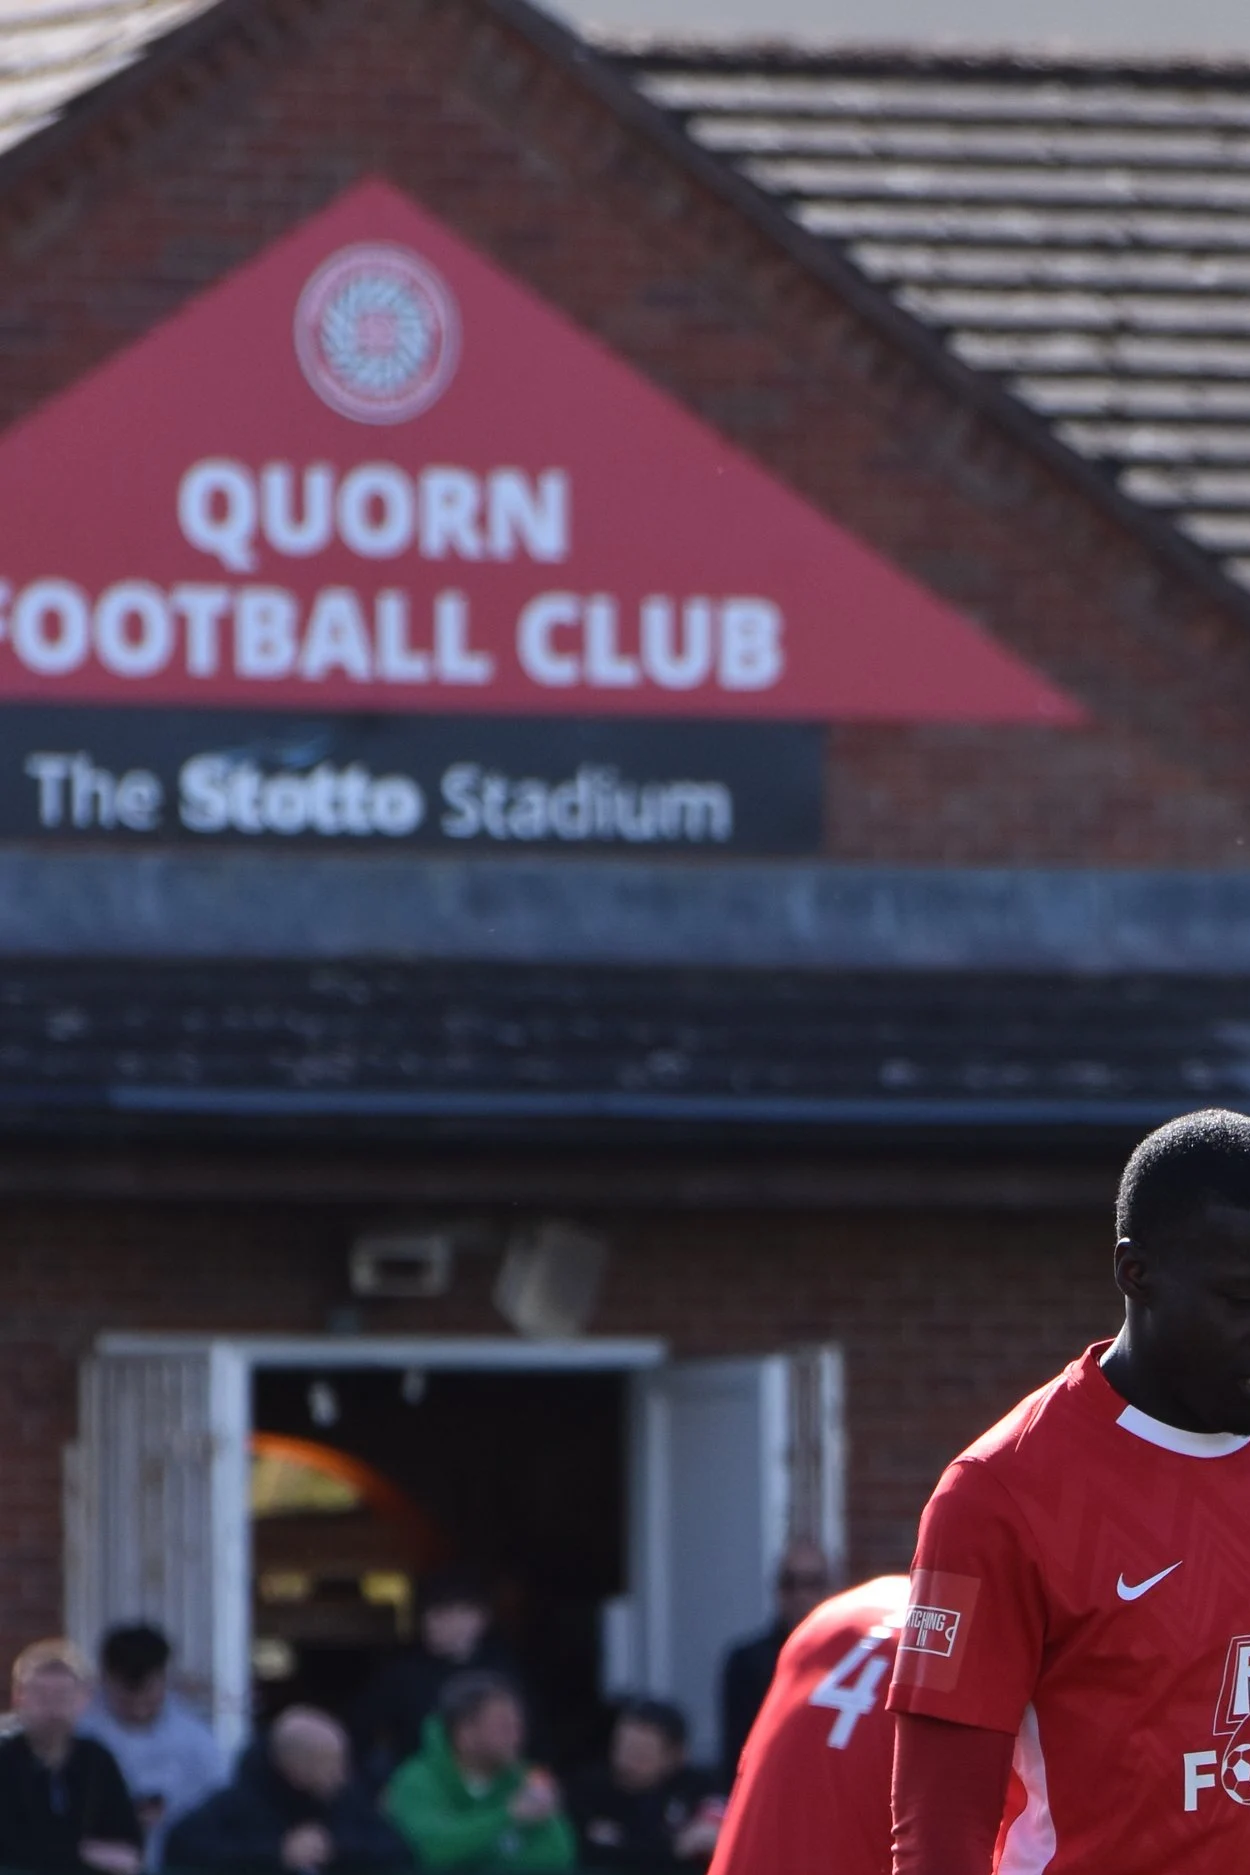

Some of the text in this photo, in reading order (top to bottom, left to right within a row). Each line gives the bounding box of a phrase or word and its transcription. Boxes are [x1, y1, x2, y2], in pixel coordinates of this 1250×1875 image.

[177, 457, 572, 574] QUORN
[0, 577, 786, 691] OOTBALL CLUB
[24, 751, 734, 842] The Stotto Stadium
[905, 1610, 946, 1632] ITCHING
[808, 1625, 893, 1750] 4
